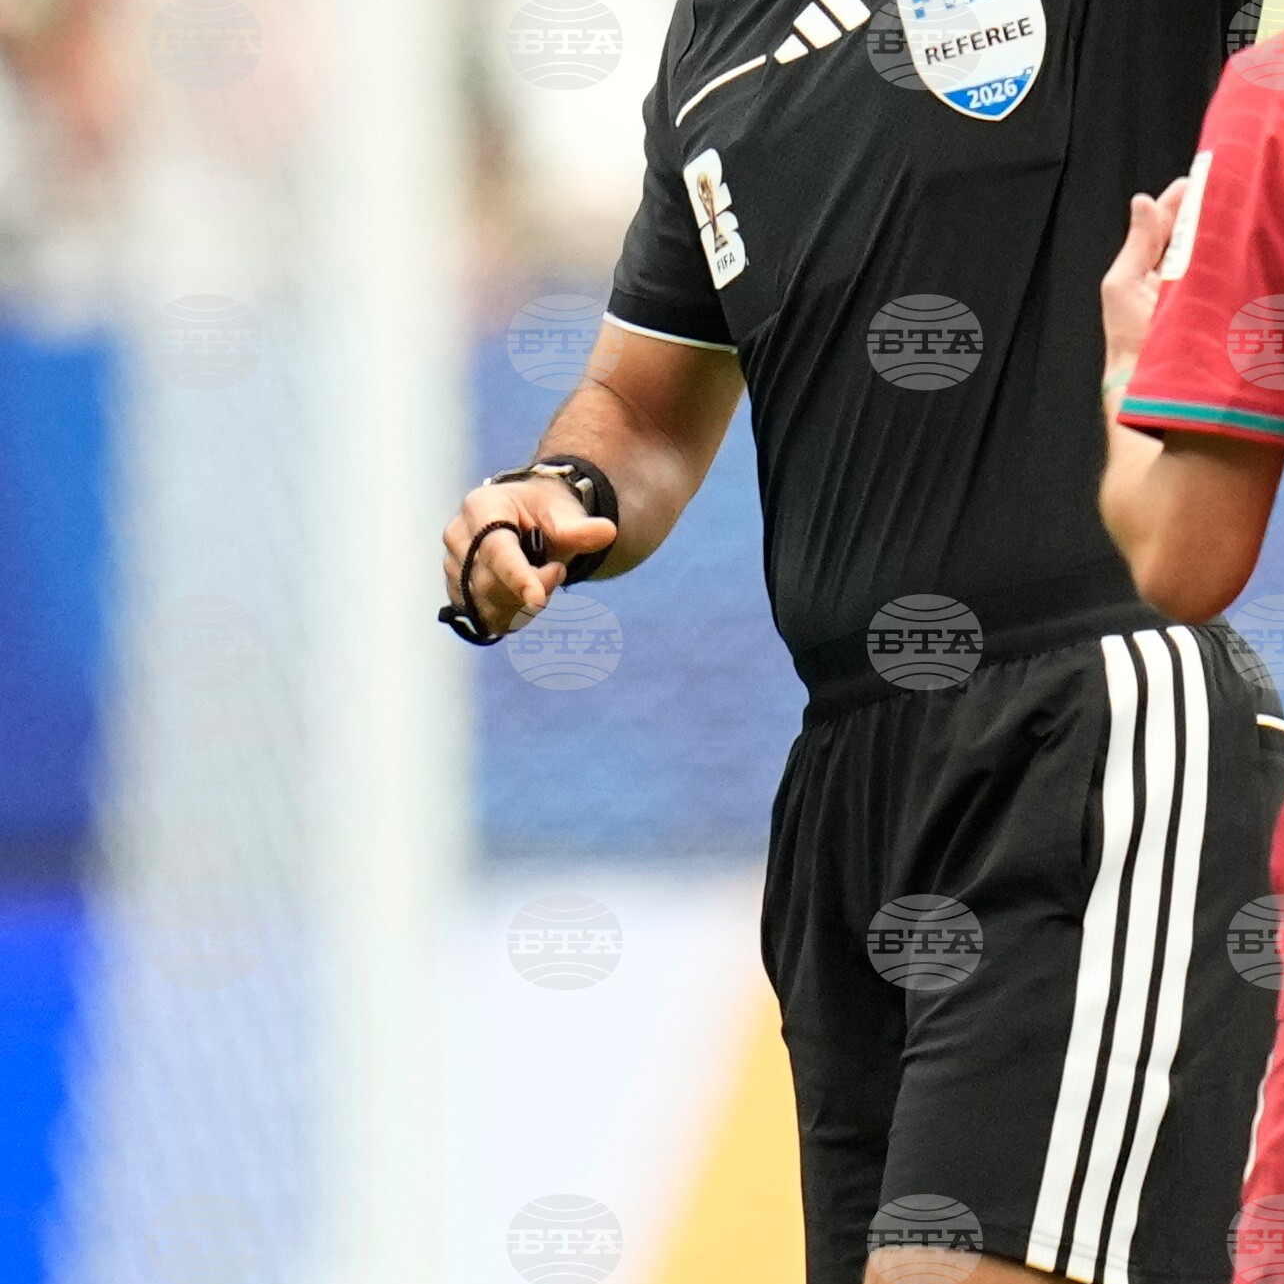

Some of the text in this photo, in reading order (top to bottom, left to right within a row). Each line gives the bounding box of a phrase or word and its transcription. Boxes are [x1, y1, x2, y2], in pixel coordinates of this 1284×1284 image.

[924, 17, 1034, 65] REFEREE
[966, 78, 1019, 110] 2026
[716, 251, 736, 274] FIFA
